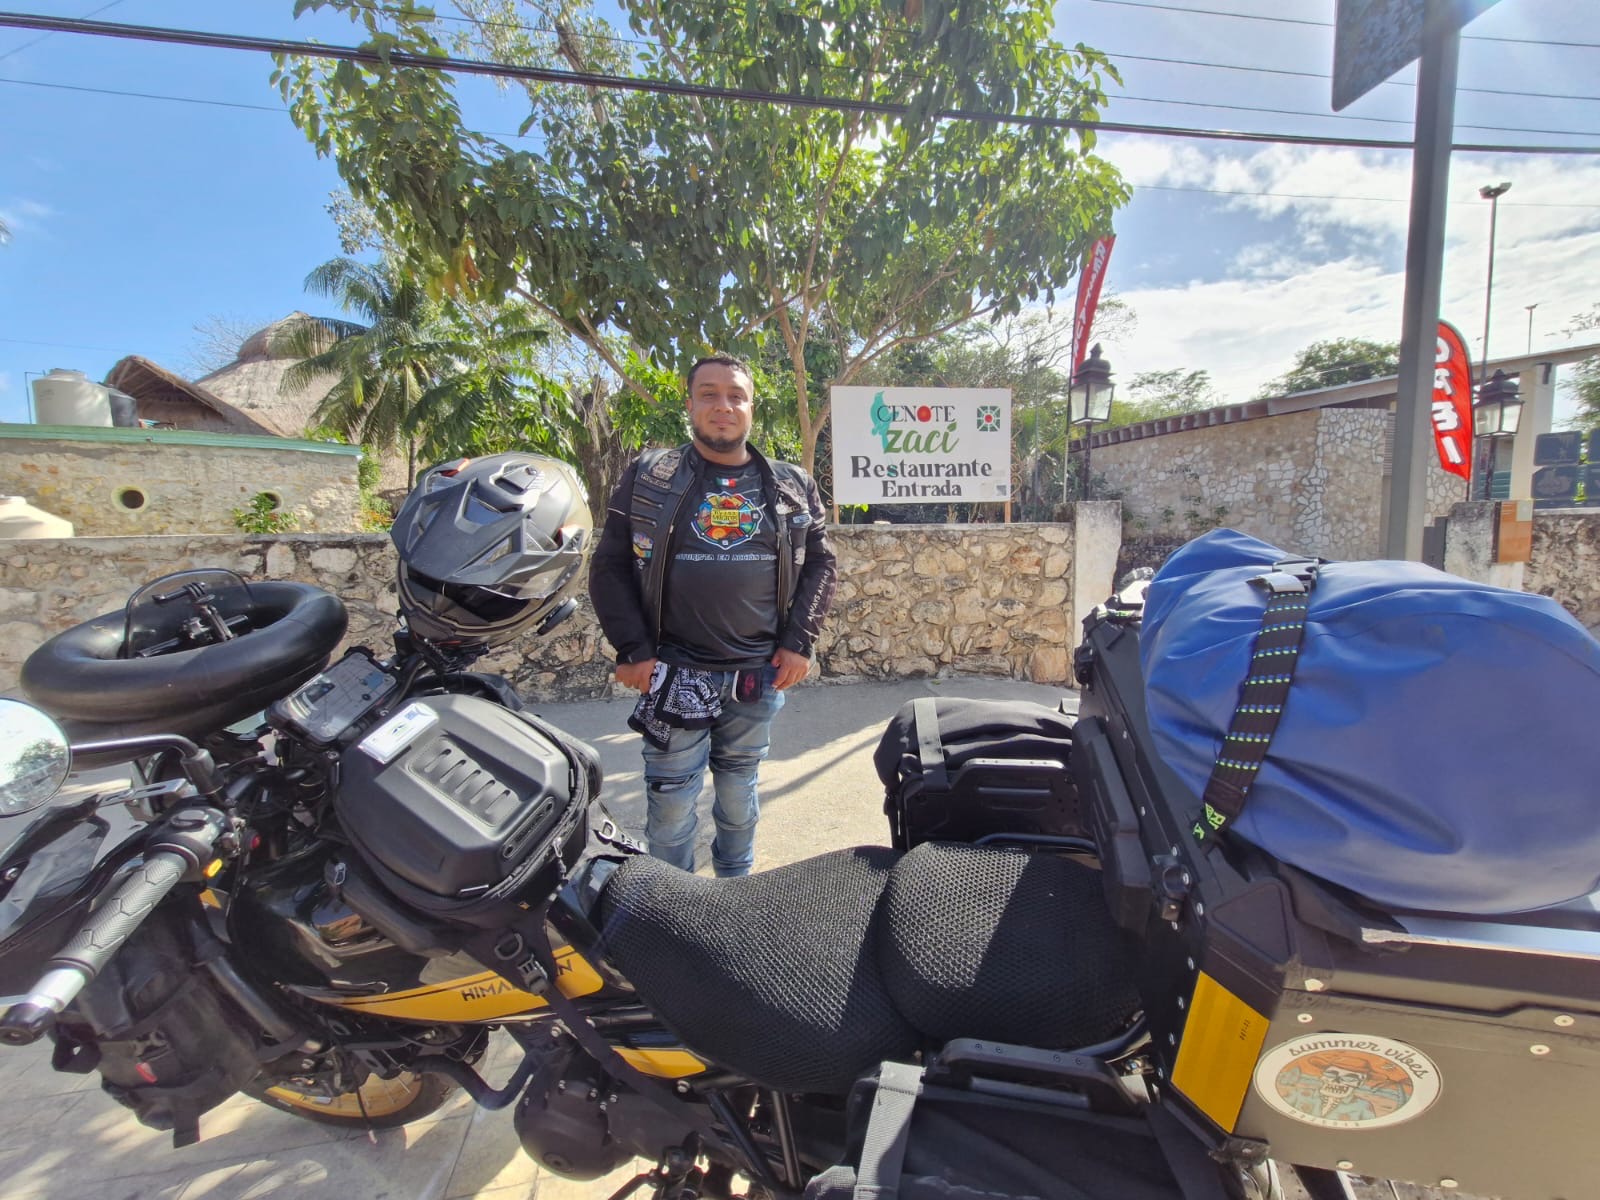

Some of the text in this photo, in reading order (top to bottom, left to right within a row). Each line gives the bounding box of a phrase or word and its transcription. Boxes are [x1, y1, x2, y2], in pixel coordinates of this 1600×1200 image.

[877, 405, 956, 423] CENOTE
[850, 455, 992, 478] Restaurante
[882, 479, 962, 498] Entrada
[1289, 1039, 1430, 1080] summer vibes
